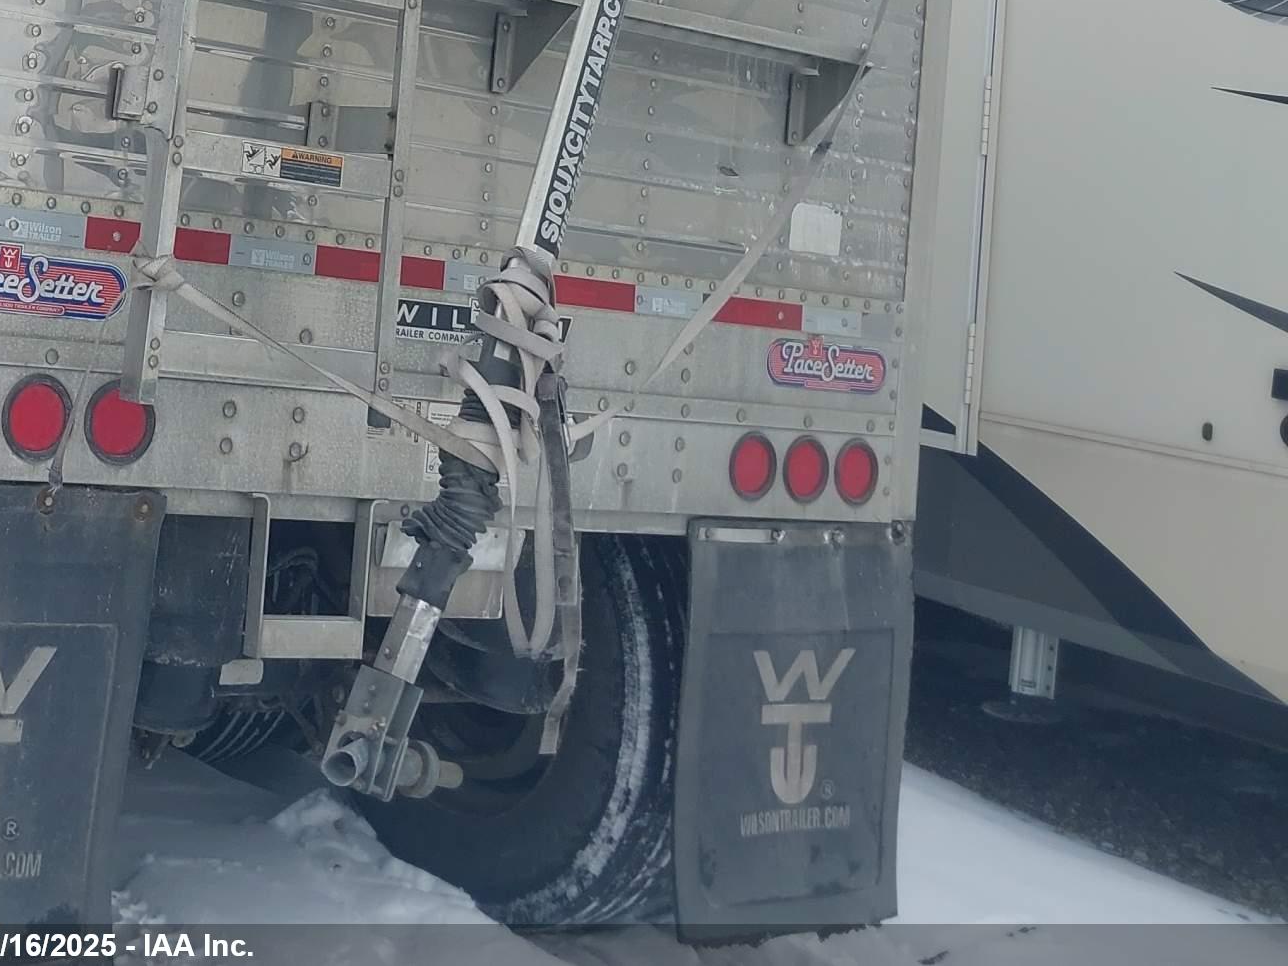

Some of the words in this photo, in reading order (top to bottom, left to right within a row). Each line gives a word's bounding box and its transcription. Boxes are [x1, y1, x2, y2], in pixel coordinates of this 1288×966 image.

[297, 153, 333, 165] WARNING
[29, 221, 62, 235] Wilson
[28, 232, 61, 242] TRAILER
[396, 327, 425, 339] RAILER
[428, 331, 466, 344] COMPA
[740, 805, 850, 837] WILSONTRAILER.COM
